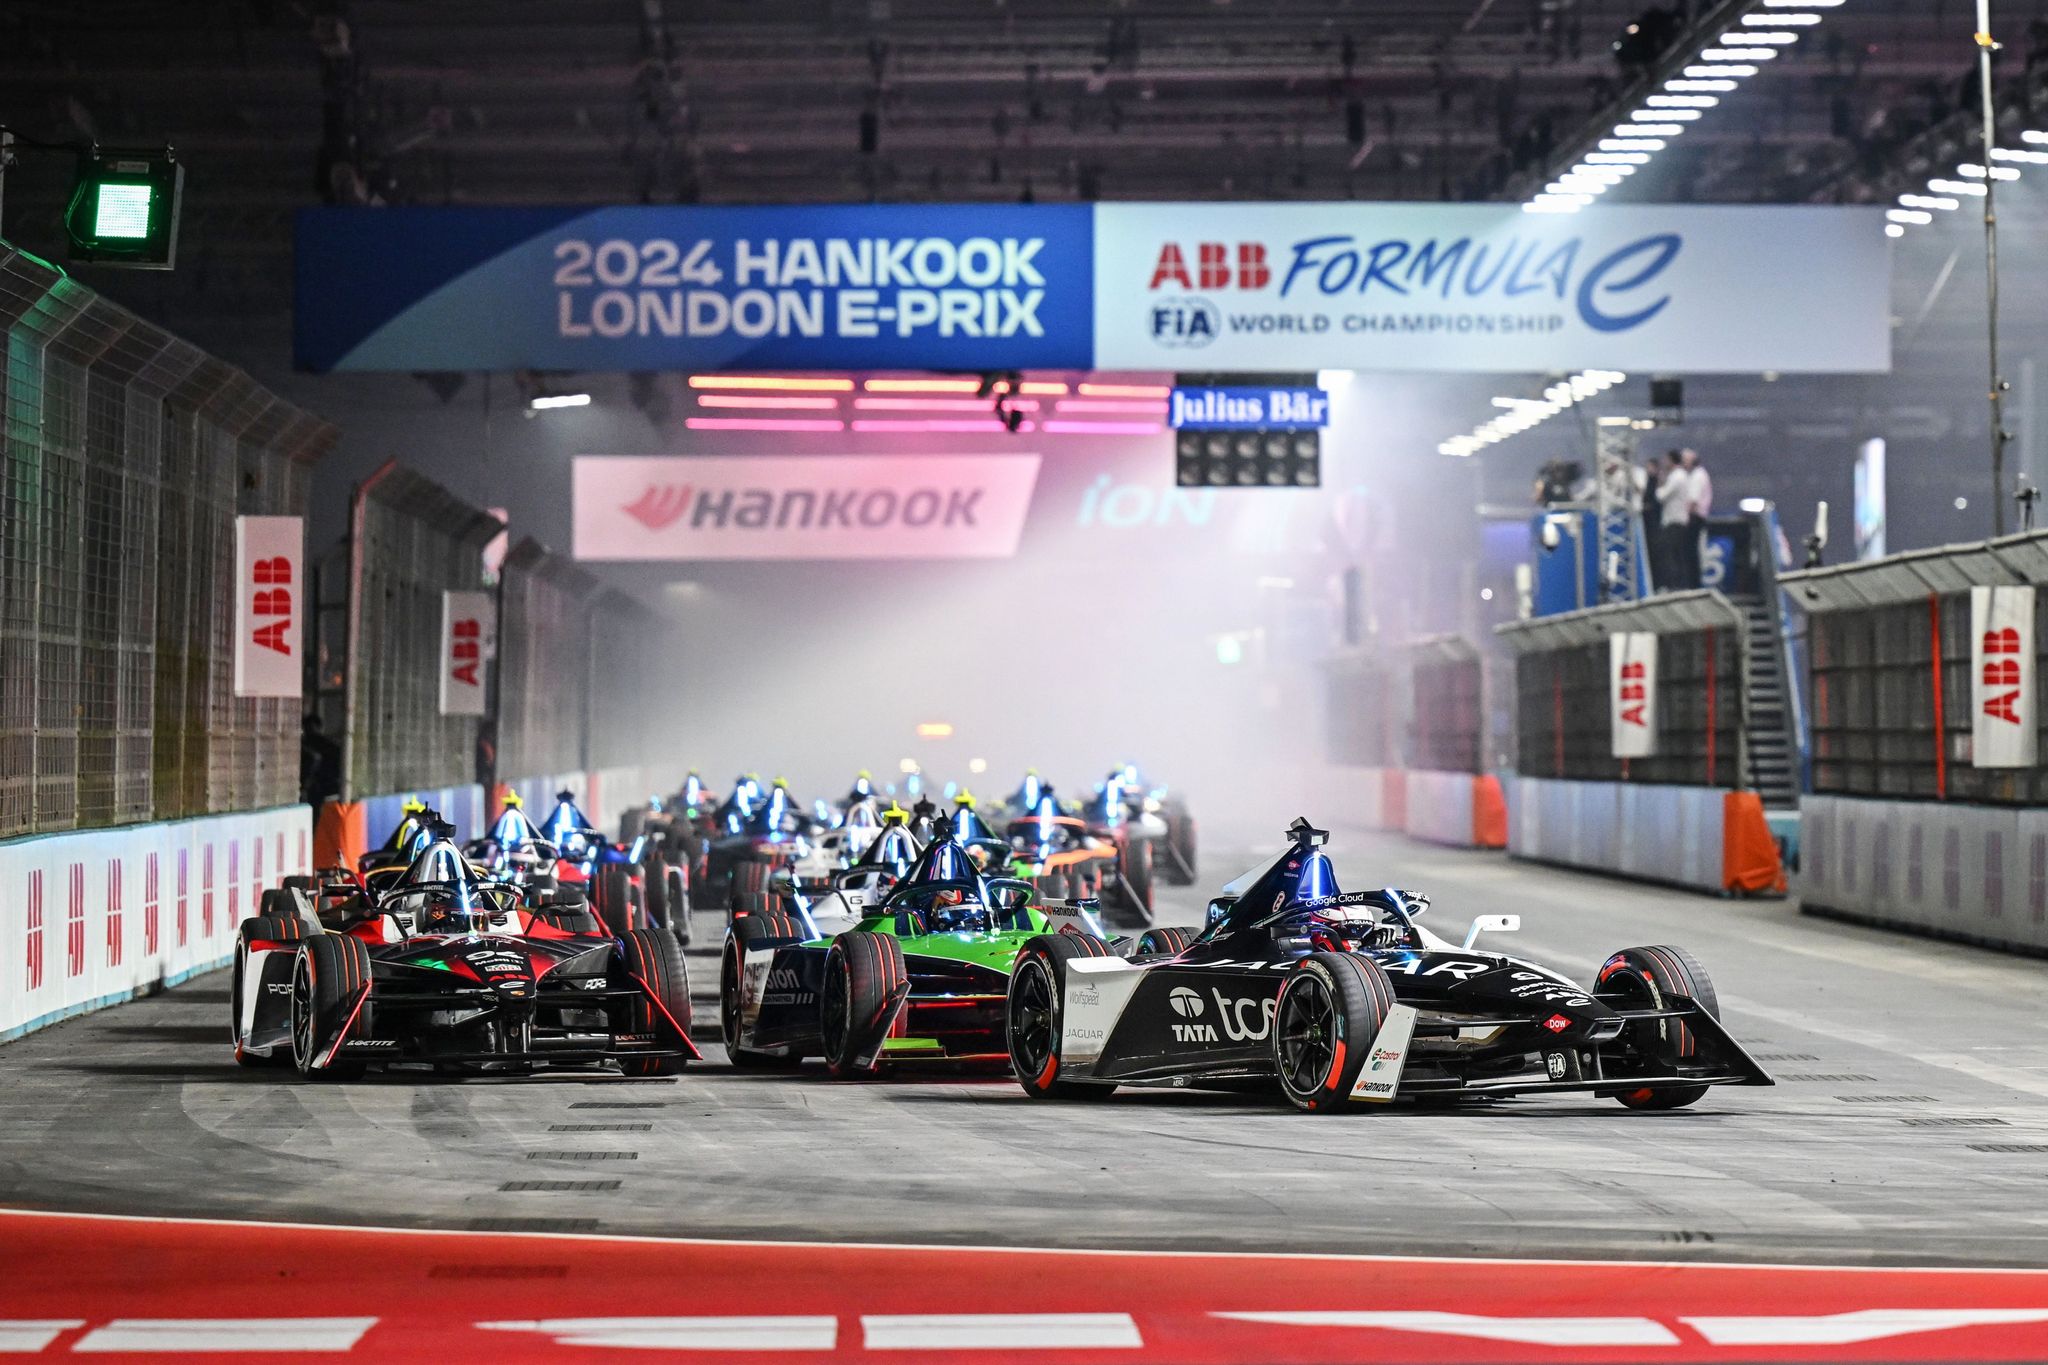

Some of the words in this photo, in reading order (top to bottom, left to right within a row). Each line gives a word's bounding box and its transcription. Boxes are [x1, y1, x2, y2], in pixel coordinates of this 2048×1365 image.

[554, 238, 723, 288] 2024
[735, 237, 1045, 288] HANKOOK
[1149, 242, 1271, 290] ABB
[1279, 235, 1583, 299] FORMULA
[558, 290, 824, 338] LONDON
[838, 289, 1045, 338] E-PRIX
[1230, 314, 1330, 333] WORLD
[1342, 314, 1564, 333] CHAMPIONSHIP
[1171, 389, 1265, 427] Julius
[1270, 389, 1328, 423] Bär
[252, 555, 292, 657] ABB
[451, 617, 481, 687] ABB
[1982, 627, 2021, 726] ABB
[1620, 660, 1647, 728] ABB
[1305, 895, 1337, 908] Google
[1338, 892, 1364, 904] Cloud
[1169, 958, 1491, 980] JAAR
[1070, 991, 1099, 1008] Wolfspeed
[1066, 1028, 1104, 1040] JAGUAR
[1171, 1024, 1219, 1042] TATA
[1549, 1020, 1566, 1029] DOW
[347, 1039, 396, 1047] LOCTITE
